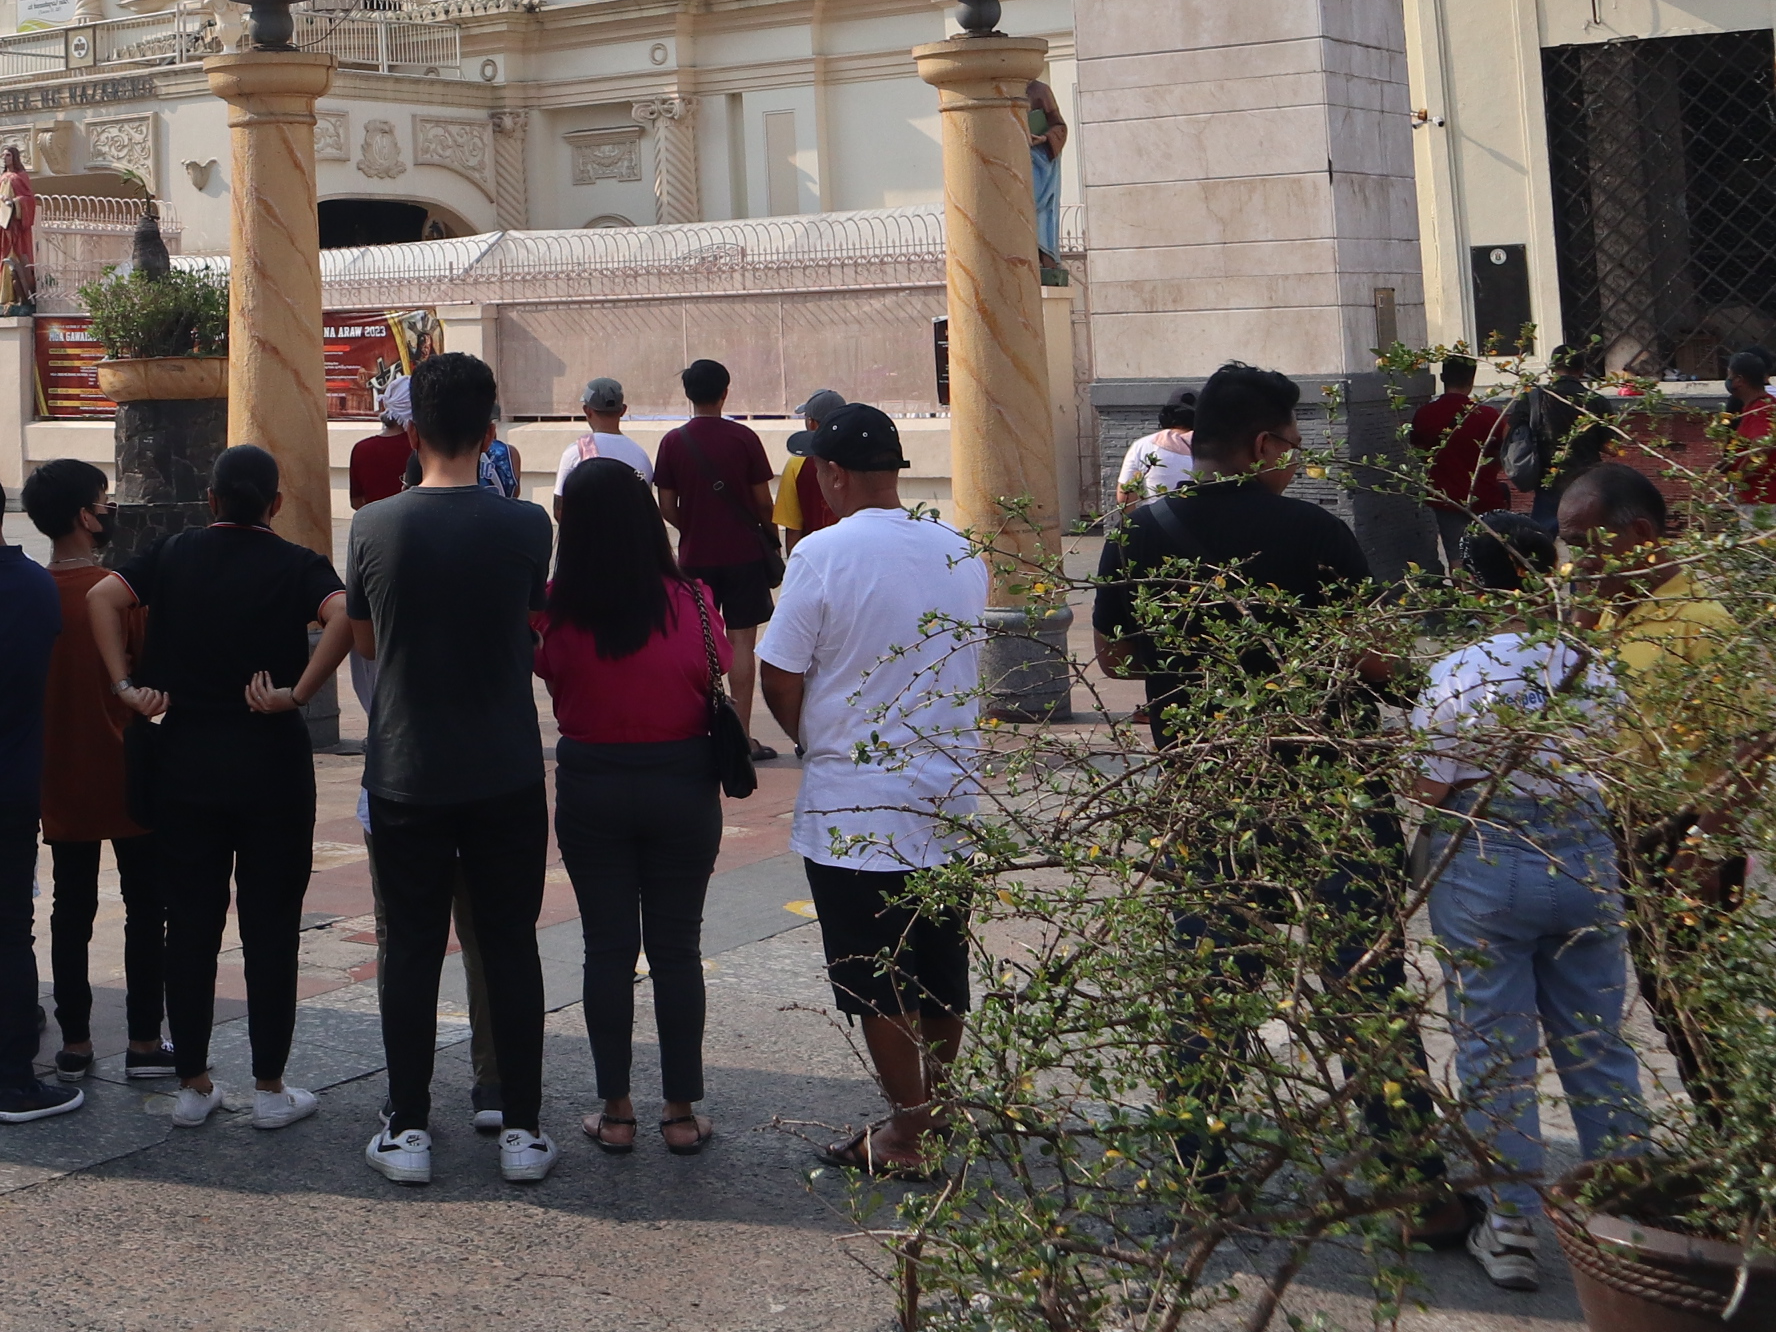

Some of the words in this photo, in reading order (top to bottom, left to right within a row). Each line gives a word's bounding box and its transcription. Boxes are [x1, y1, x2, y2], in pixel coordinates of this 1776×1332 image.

[324, 327, 335, 338] NA
[338, 326, 362, 337] ARAW
[365, 326, 386, 337] 2023
